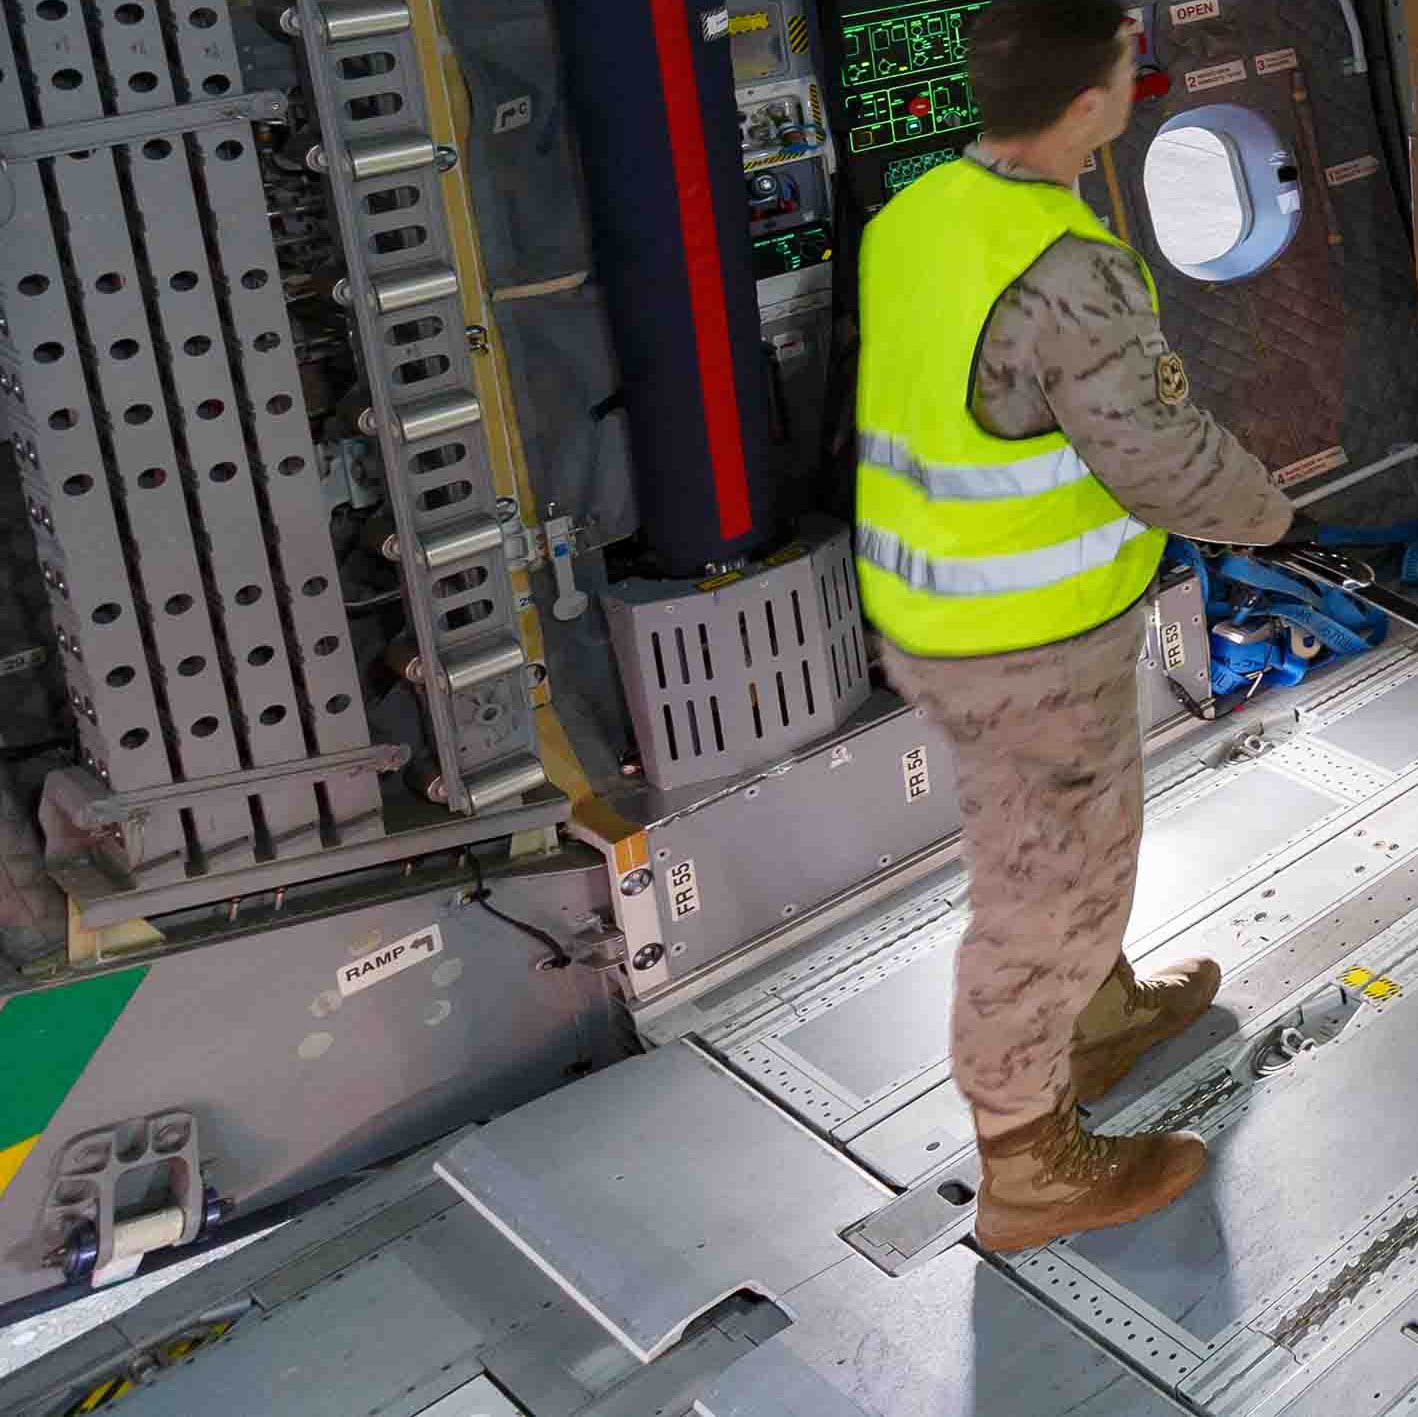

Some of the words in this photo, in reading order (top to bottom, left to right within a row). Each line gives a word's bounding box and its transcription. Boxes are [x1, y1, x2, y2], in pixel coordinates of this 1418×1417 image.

[1176, 1, 1214, 21] OPEN
[1255, 60, 1265, 71] 3
[1187, 76, 1197, 88] 2
[1164, 624, 1179, 644] 53
[1165, 644, 1182, 669] FR
[907, 748, 924, 770] 54
[909, 770, 927, 799] FR
[671, 862, 691, 887] 55
[675, 887, 696, 917] FR
[343, 945, 406, 983] RAMP
